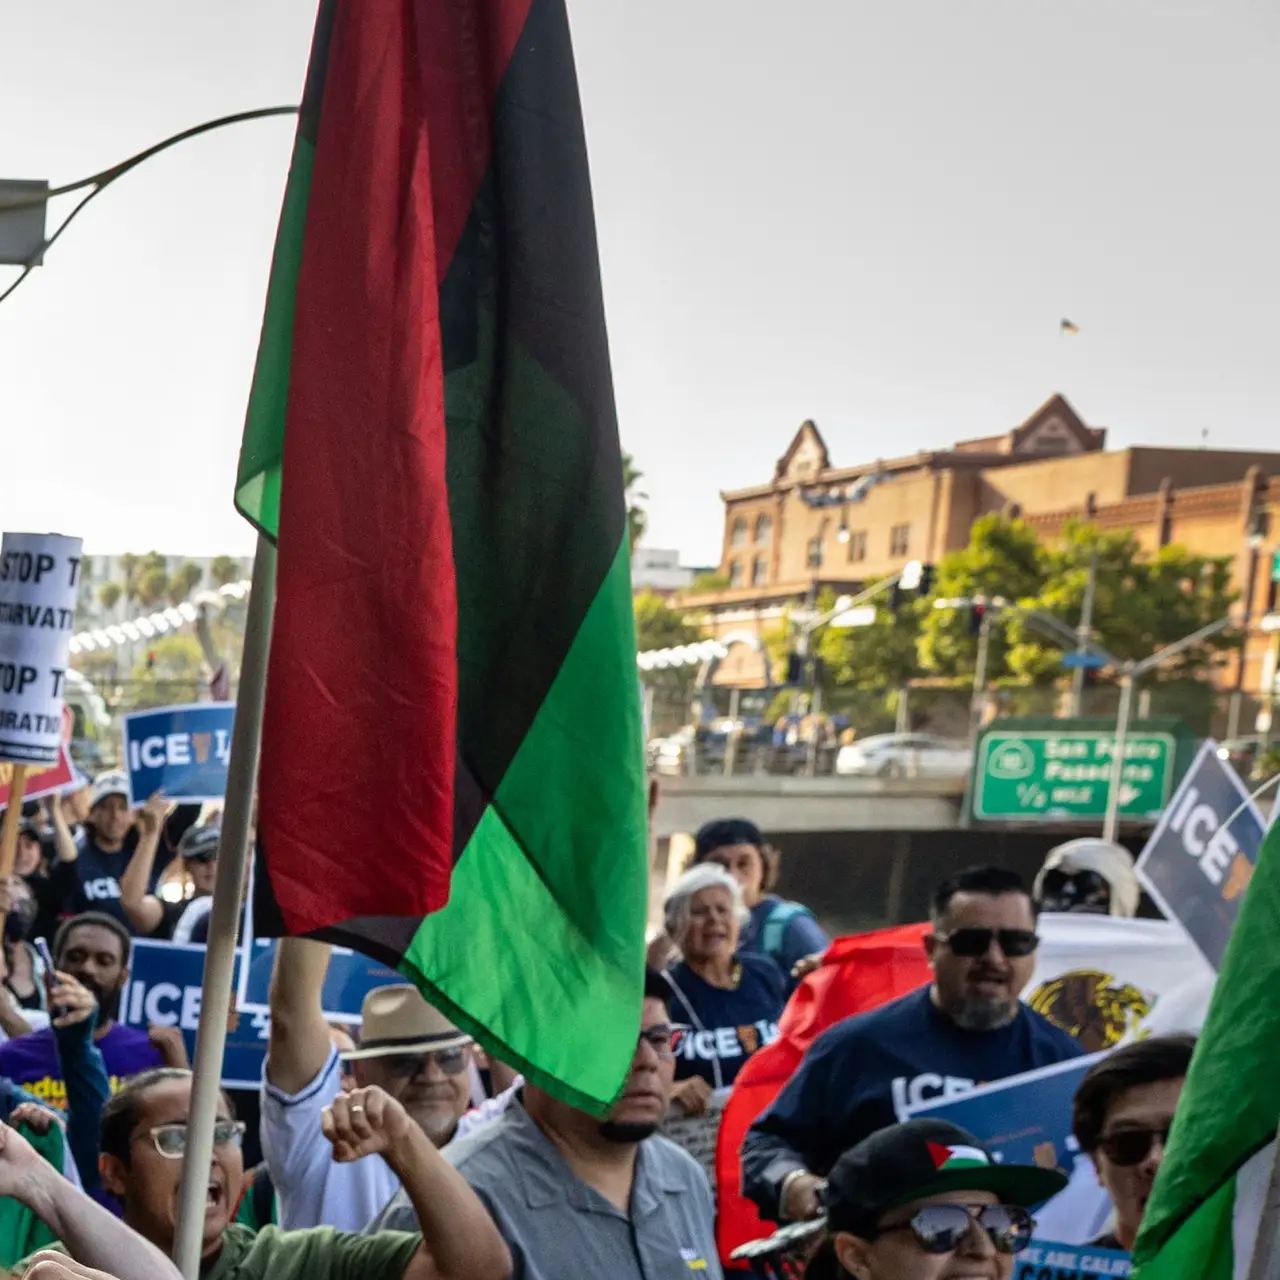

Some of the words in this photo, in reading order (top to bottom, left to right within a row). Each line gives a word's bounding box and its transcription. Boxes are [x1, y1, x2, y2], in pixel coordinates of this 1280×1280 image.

[0, 551, 55, 584] STOP
[129, 731, 191, 772] ICE
[1170, 785, 1239, 886] ICE
[128, 979, 206, 1032] ICE
[683, 1028, 742, 1060] ICE
